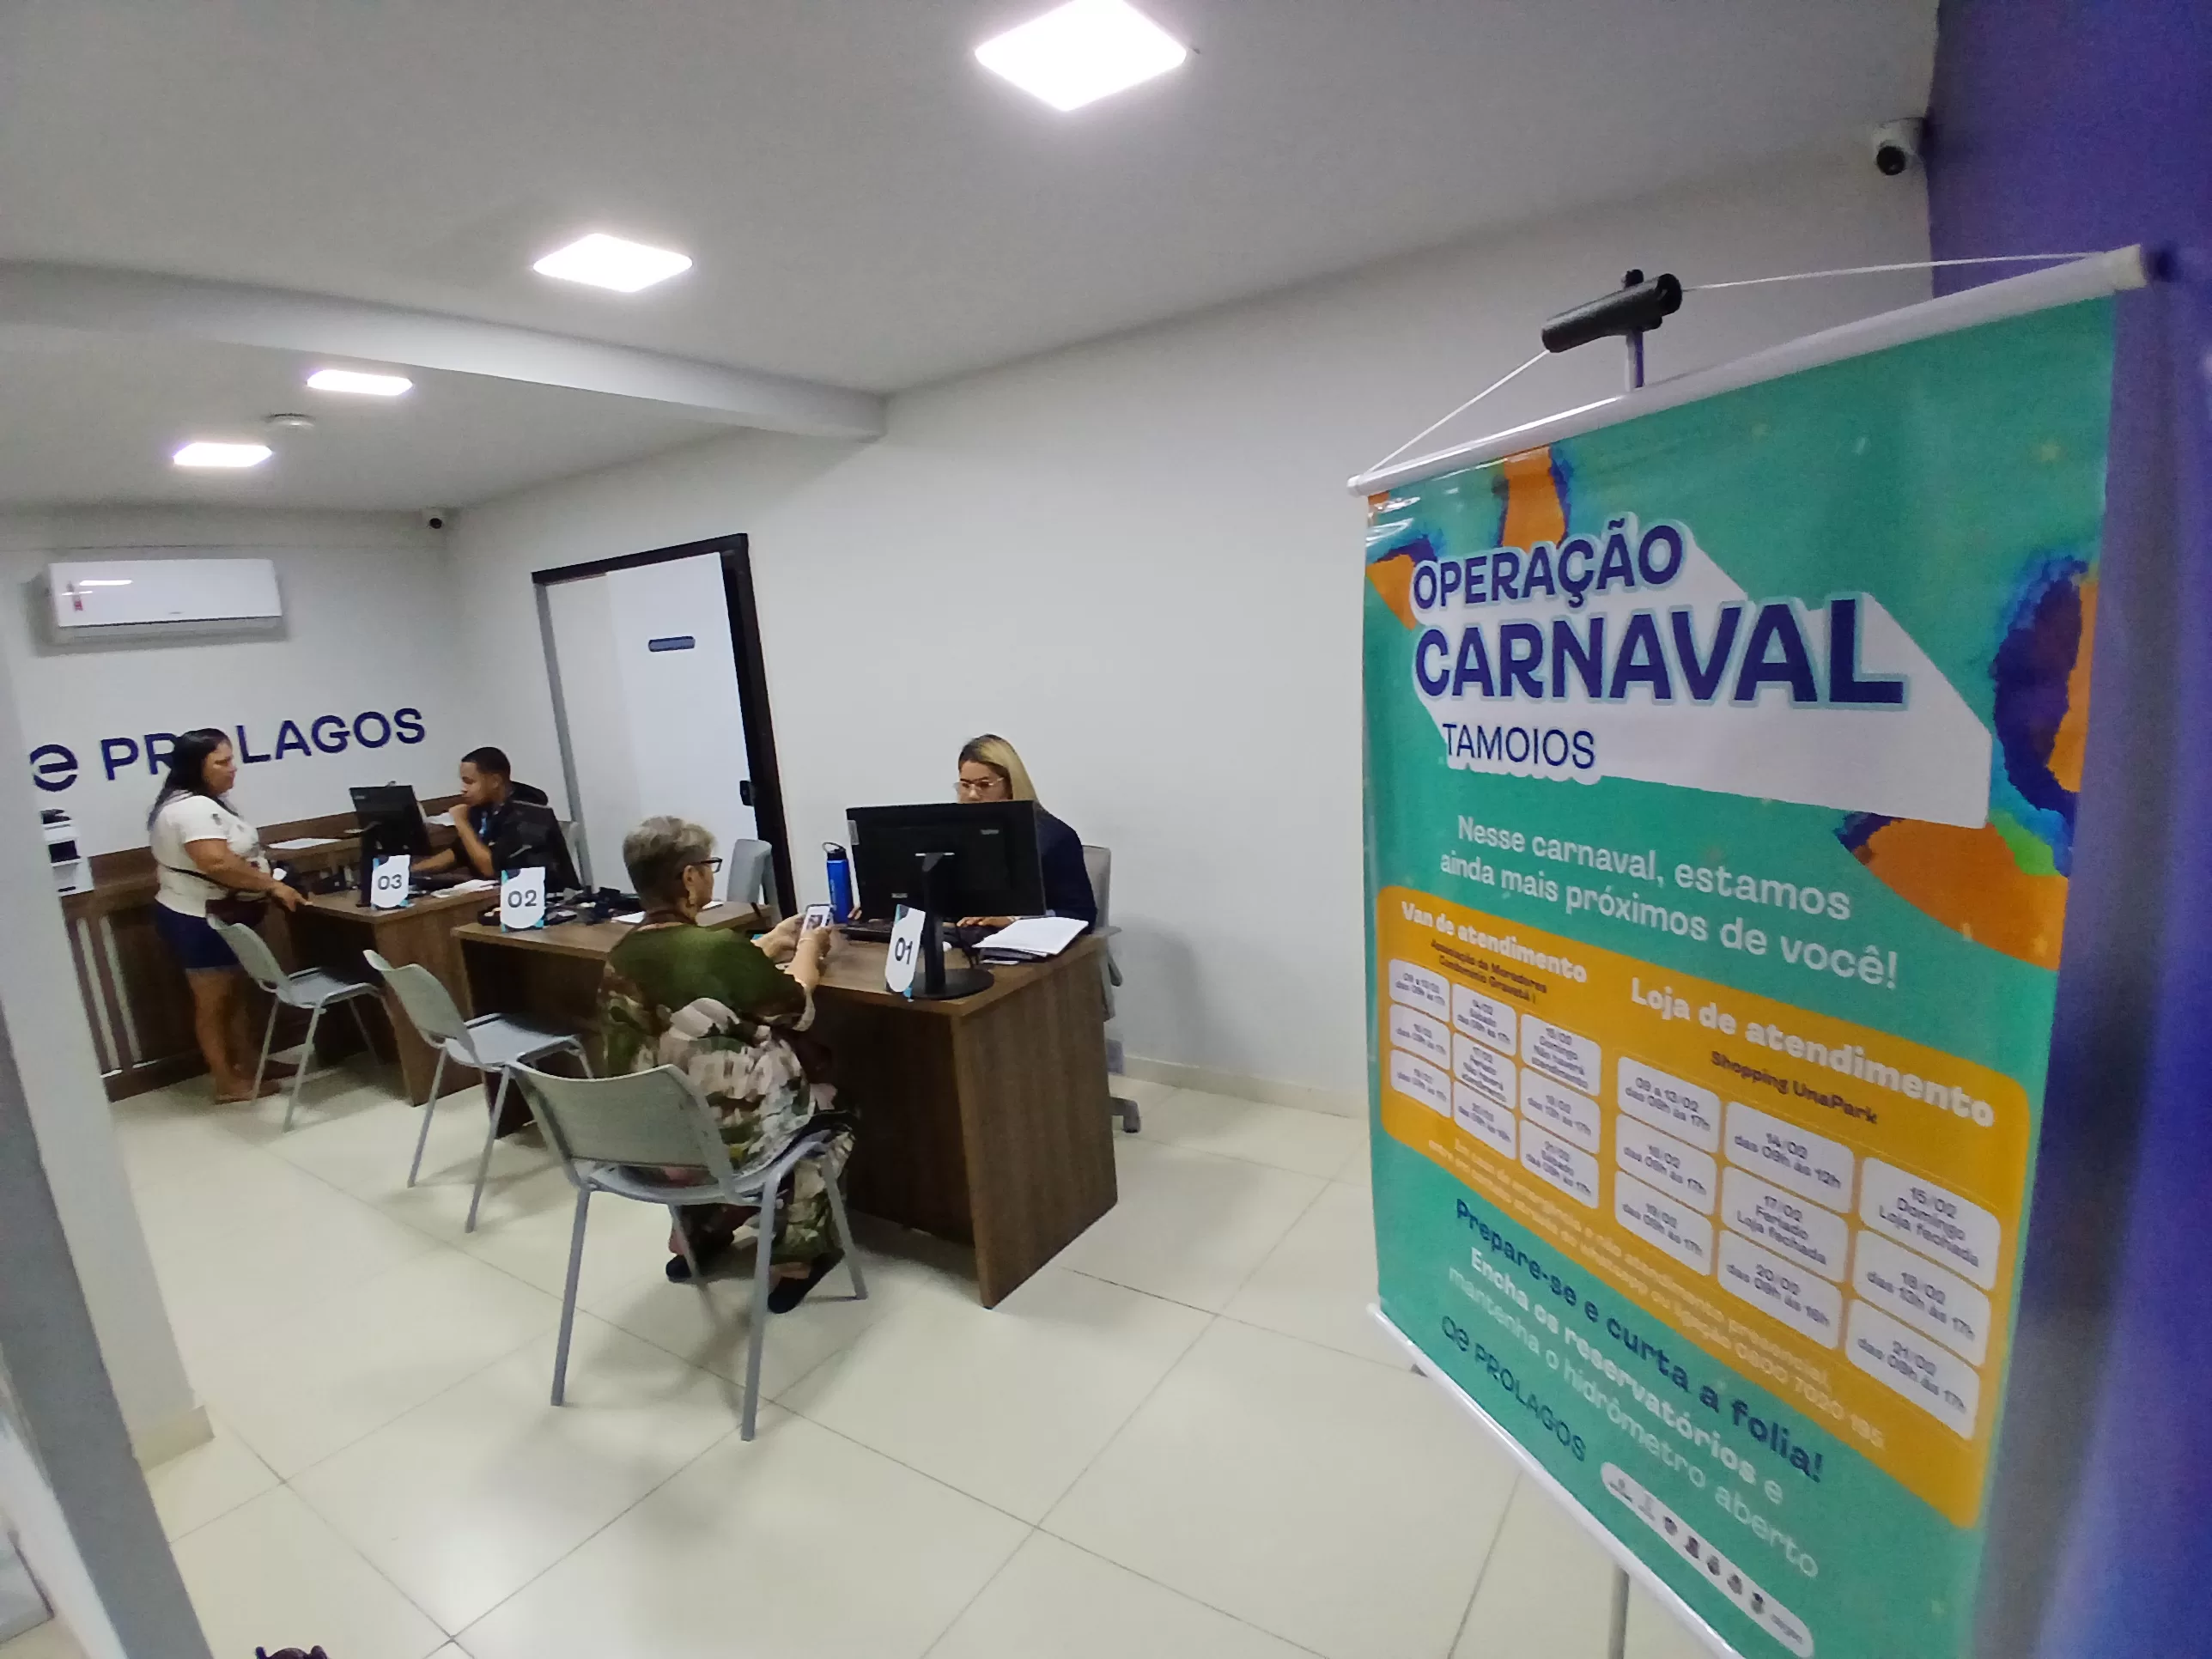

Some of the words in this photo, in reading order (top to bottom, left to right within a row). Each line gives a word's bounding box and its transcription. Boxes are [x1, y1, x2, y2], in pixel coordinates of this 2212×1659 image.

[1413, 518, 1683, 609] OPERAÇÃO
[1416, 599, 1904, 704] CARNAVAL
[100, 708, 426, 780] PRLAGOS
[1443, 723, 1595, 769] TAMOIOS
[378, 874, 402, 890] 03
[508, 890, 537, 908] 02
[1458, 814, 1525, 853] Nesse
[1532, 835, 1664, 889] carnaval,
[1674, 863, 1851, 921] estamos
[895, 937, 913, 965] 01
[1401, 901, 1432, 928] Van
[1436, 911, 1453, 935] de
[1458, 925, 1587, 983] atendimento
[1440, 852, 1495, 887] ainda
[1501, 872, 1559, 902] mais
[1565, 883, 1707, 942] próximos
[1719, 917, 1767, 955] de
[1779, 936, 1897, 989] você!
[1632, 977, 1690, 1020] Loja
[1699, 1001, 1735, 1035] de
[1746, 1022, 1994, 1127] atendimento
[1711, 1050, 1789, 1094] Shopping
[1793, 1081, 1877, 1124] UnaPark
[1456, 1200, 1577, 1306] Prepare-se
[1585, 1300, 1599, 1322] e
[1607, 1316, 1690, 1393] curta
[1699, 1382, 1720, 1413] a
[1732, 1399, 1824, 1482] folia!
[1471, 1247, 1529, 1312] Encha
[1534, 1304, 1559, 1334] os
[1564, 1325, 1756, 1485] reservatórios
[1765, 1480, 1783, 1504] e
[1449, 1265, 1540, 1355] mantenha
[1546, 1349, 1559, 1370] o
[1564, 1358, 1706, 1487] hidrômetro
[1715, 1483, 1819, 1578] aberto
[1474, 1347, 1586, 1462] PROLAGOS
